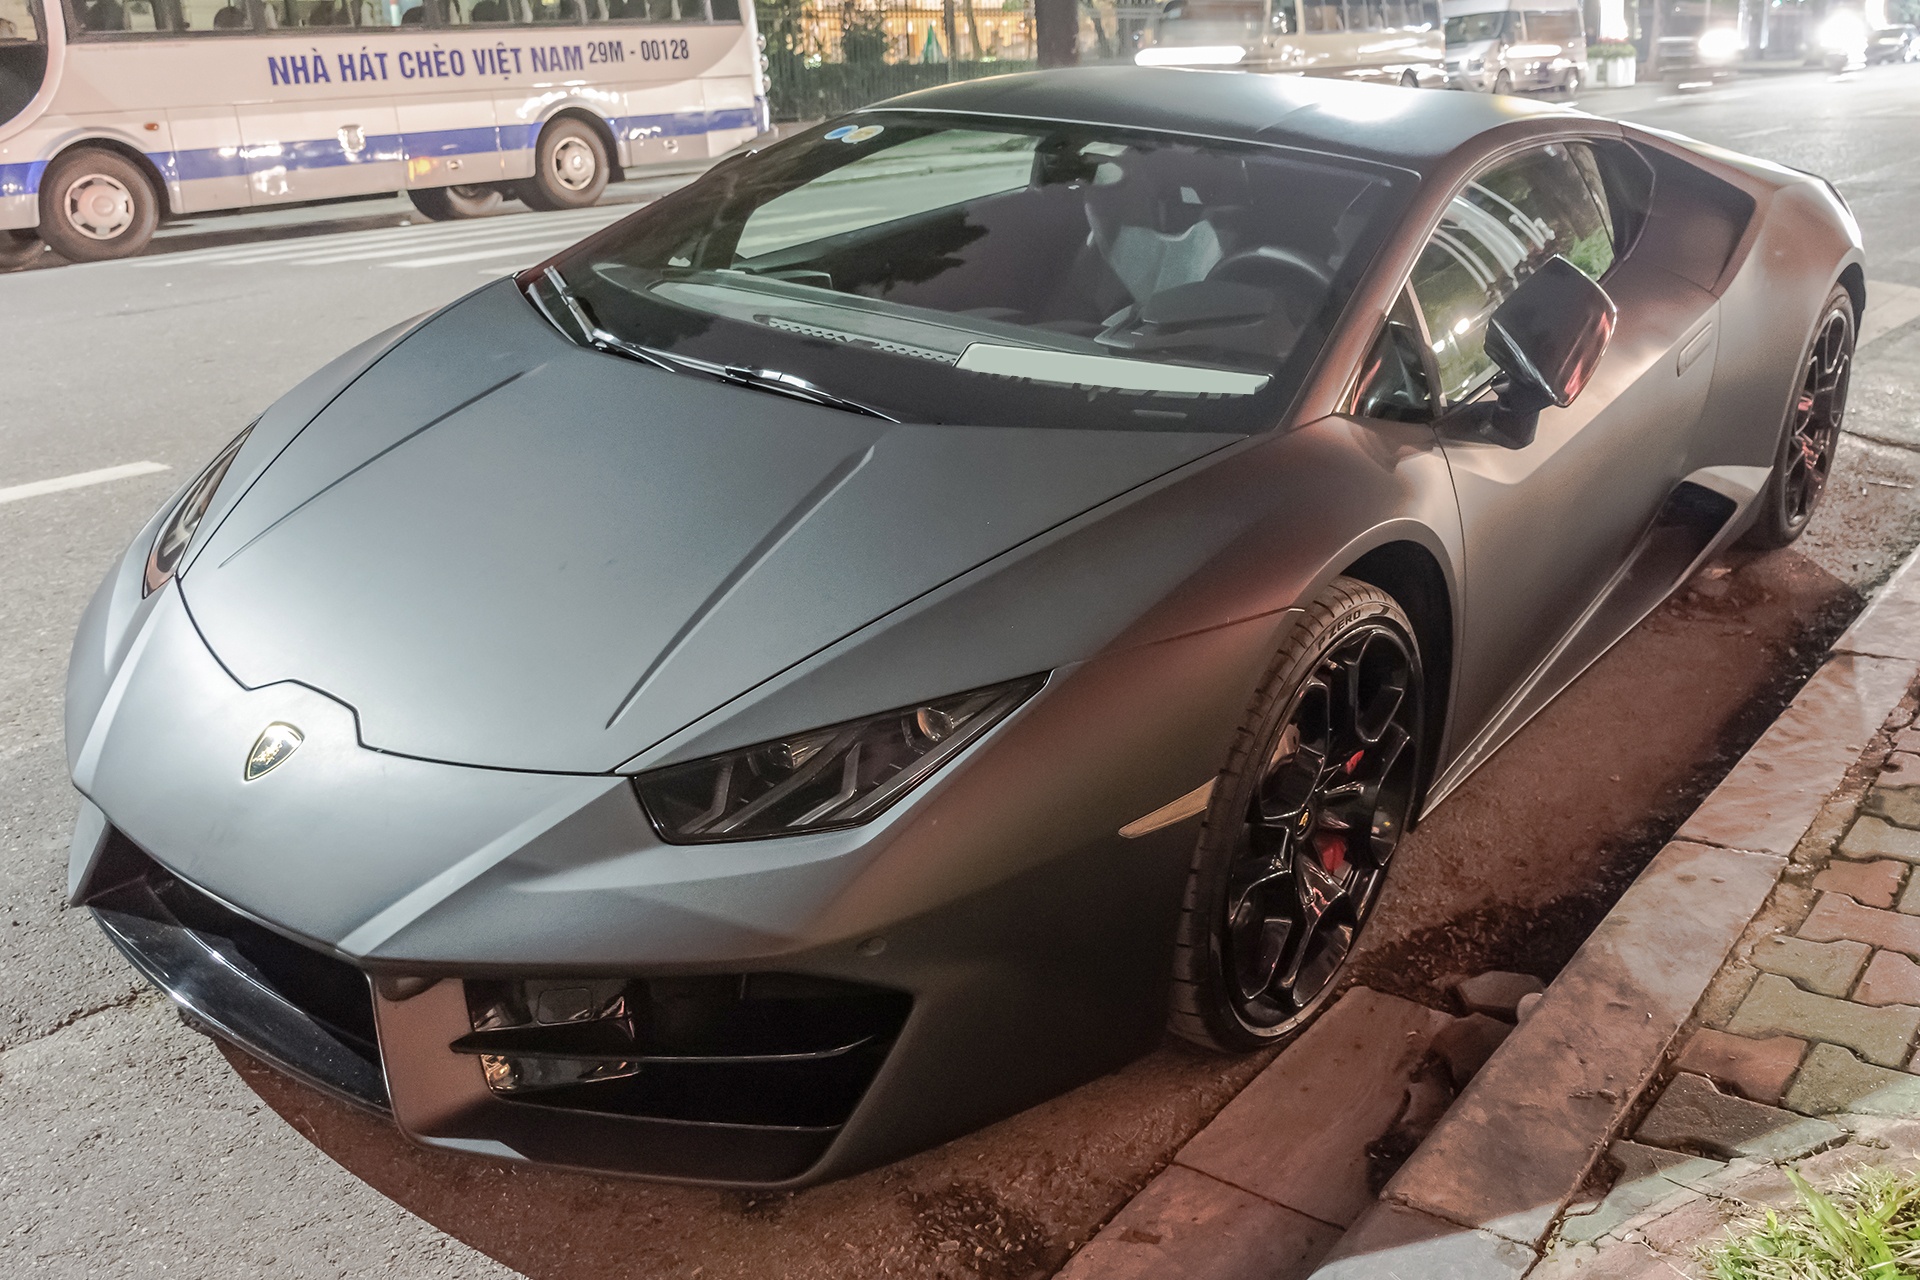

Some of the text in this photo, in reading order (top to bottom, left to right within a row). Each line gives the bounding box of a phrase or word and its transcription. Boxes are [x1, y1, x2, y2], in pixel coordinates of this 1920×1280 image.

[268, 41, 584, 86] NHÀ HÁT CHÈO VIỆT NAM
[588, 40, 624, 64] 29M
[641, 38, 690, 62] 00128
[1318, 609, 1361, 651] P ZERO
